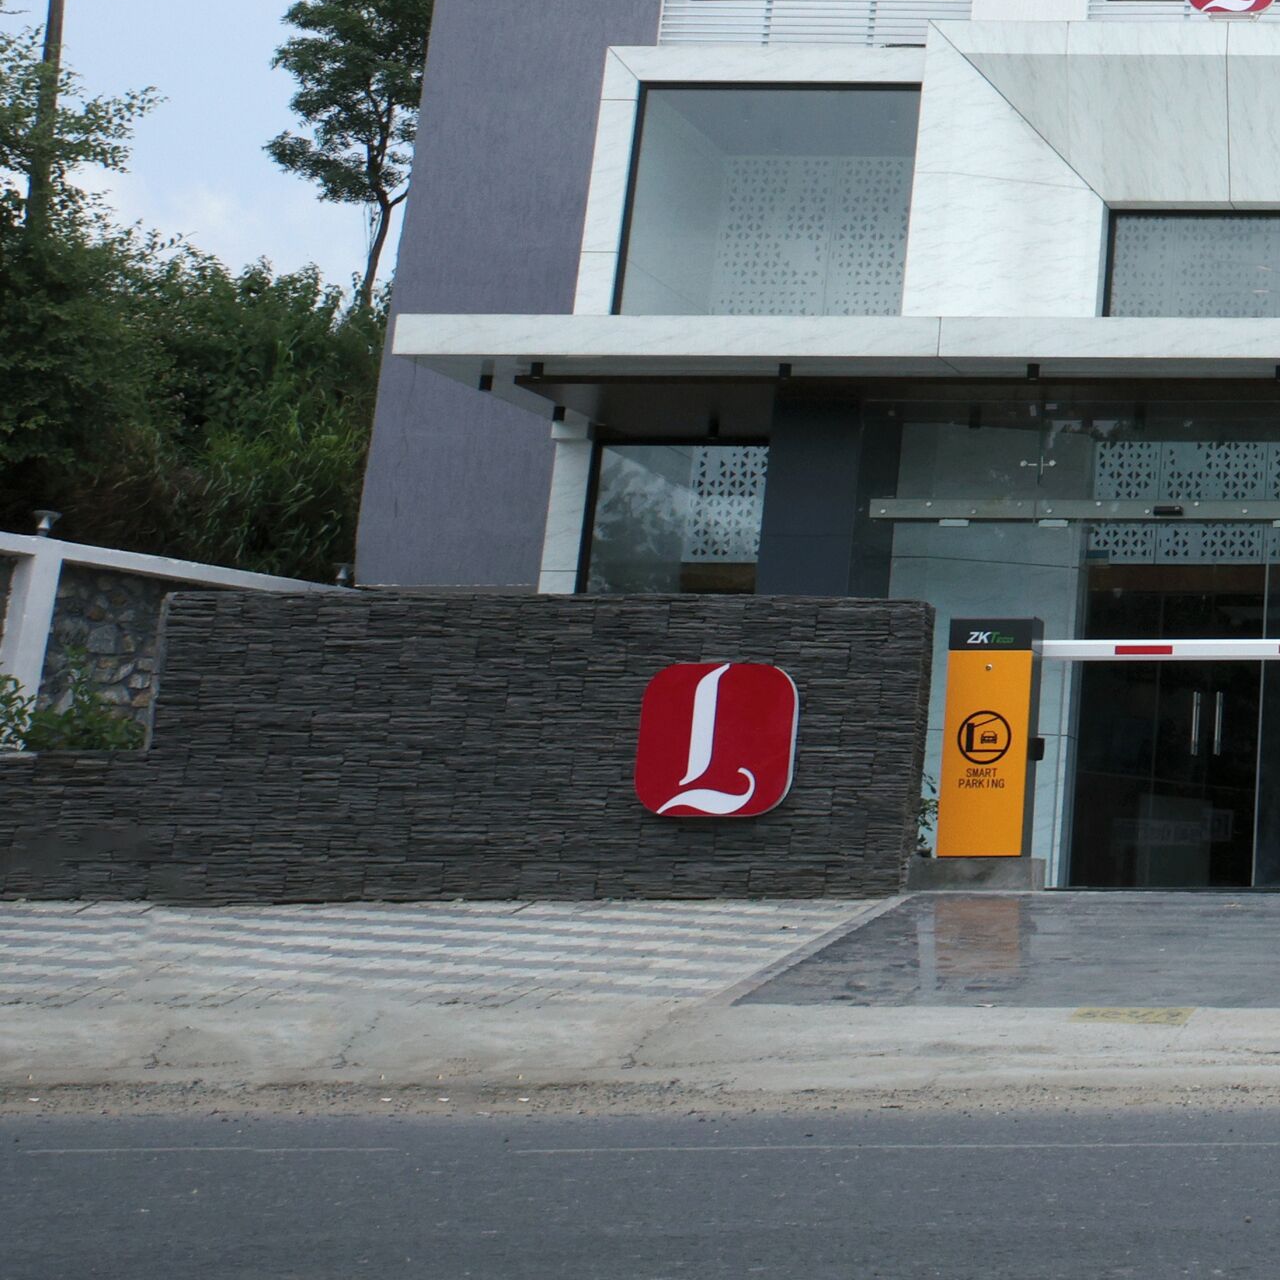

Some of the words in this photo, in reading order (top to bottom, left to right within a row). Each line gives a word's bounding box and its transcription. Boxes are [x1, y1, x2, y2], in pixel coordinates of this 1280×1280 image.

[656, 662, 756, 815] L
[966, 767, 998, 778] SMART
[958, 778, 1005, 789] PARKING
